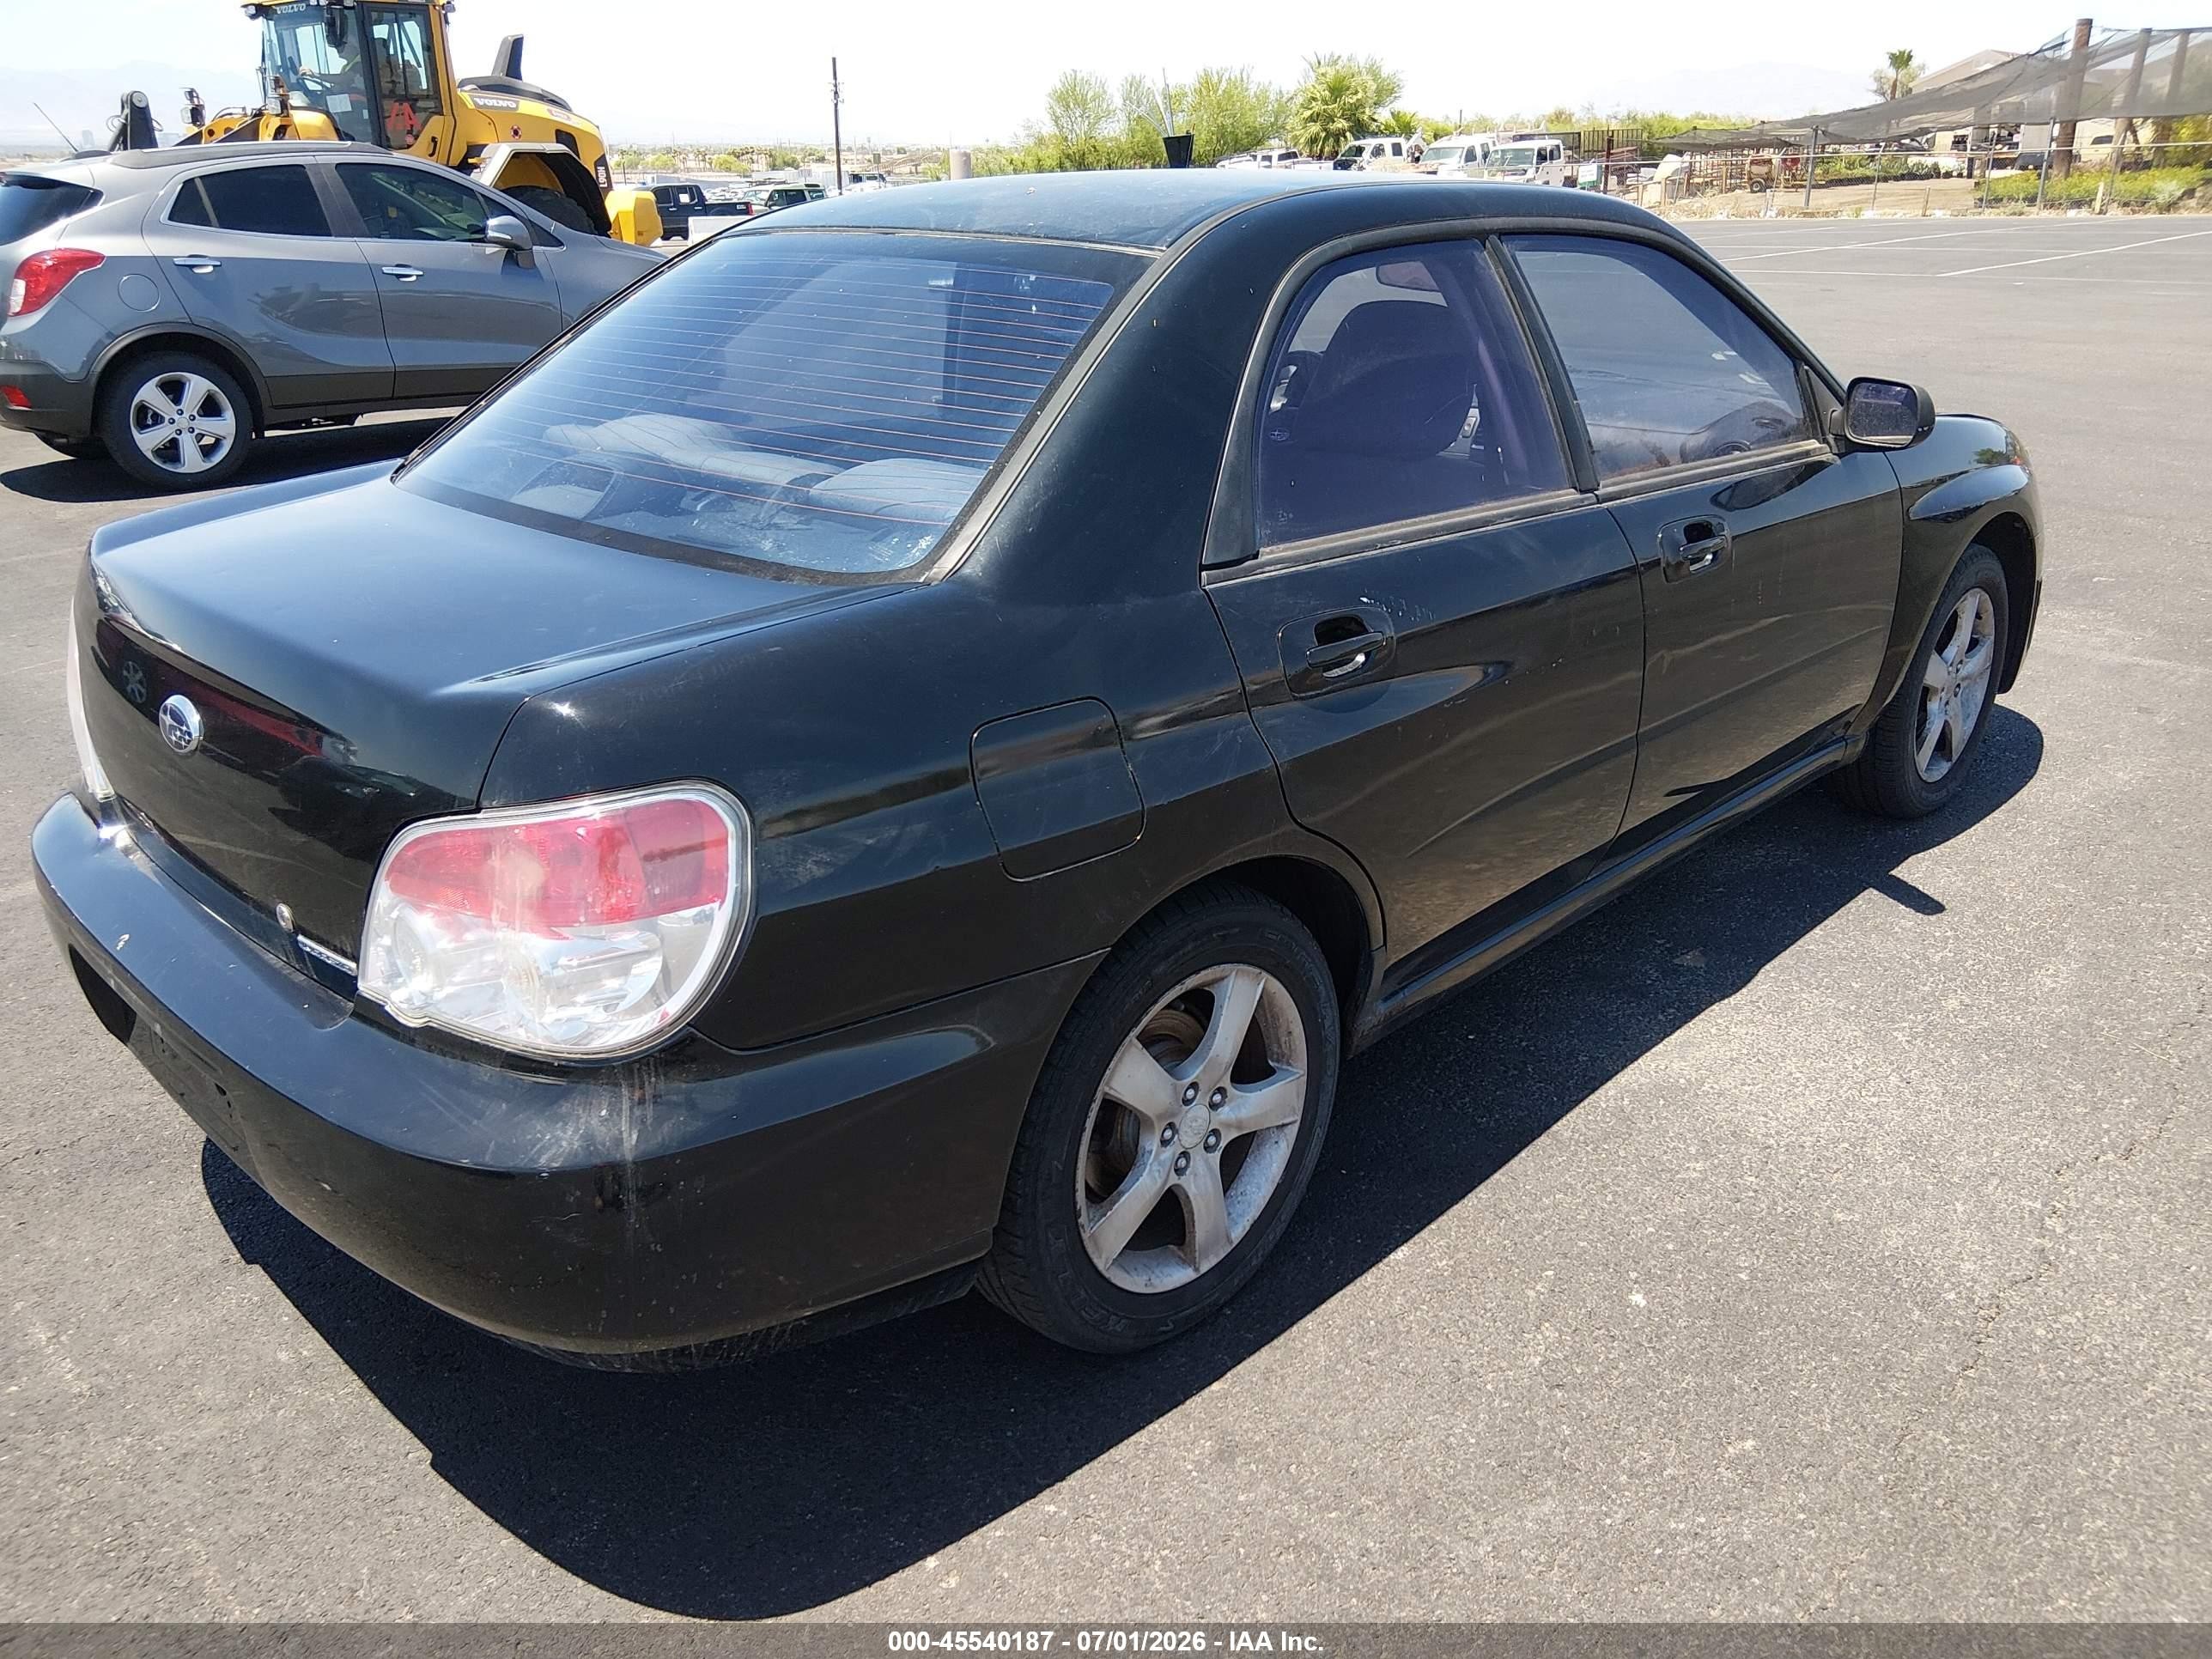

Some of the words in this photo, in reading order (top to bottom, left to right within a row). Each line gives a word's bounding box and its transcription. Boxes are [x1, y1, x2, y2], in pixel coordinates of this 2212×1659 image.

[276, 3, 307, 15] VOLVO
[473, 97, 518, 109] VOLVO
[596, 166, 609, 188] L90H
